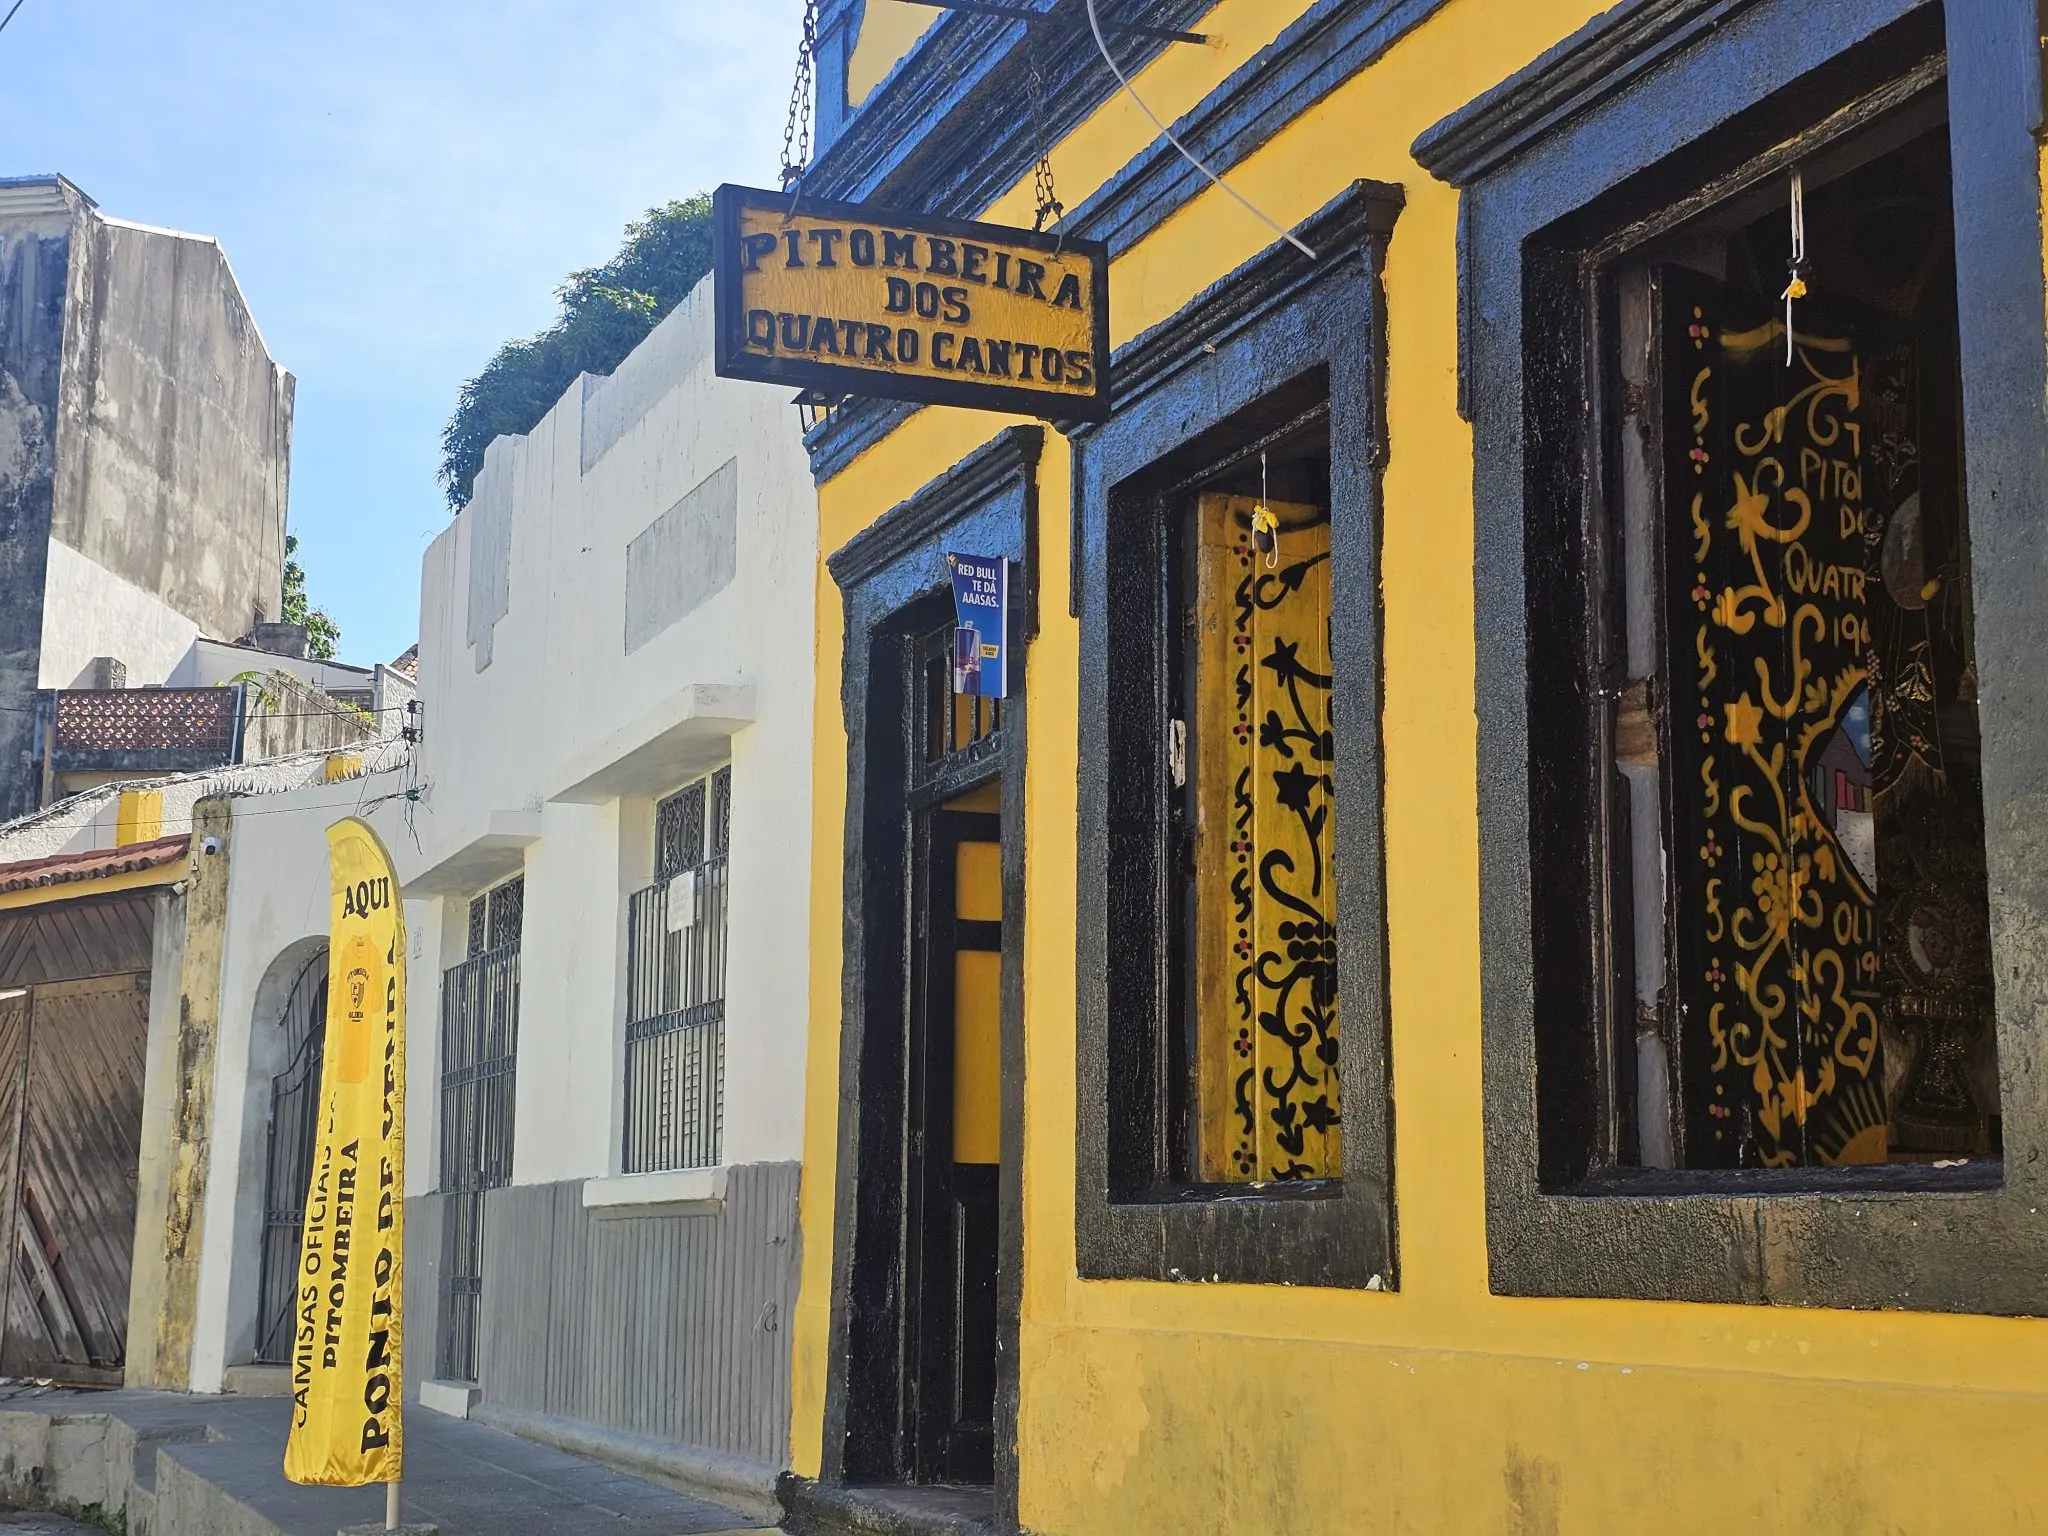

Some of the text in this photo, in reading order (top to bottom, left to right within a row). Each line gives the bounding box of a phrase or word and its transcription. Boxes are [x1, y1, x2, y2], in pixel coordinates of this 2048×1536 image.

[743, 228, 1083, 311] PITOMBEIRA
[885, 276, 970, 325] DOS
[748, 309, 1091, 386] QUATRO CANTOS
[1801, 448, 1863, 501] PITO
[958, 563, 997, 581] RED BULL
[972, 578, 997, 594] TE DÁ
[962, 592, 1000, 608] AAASAS.
[342, 876, 389, 920] AQUI
[323, 1138, 359, 1369] PITOMBEIRA
[361, 1247, 393, 1455] PONTO
[378, 1155, 393, 1232] DE
[295, 1284, 319, 1428] CAMISAS
